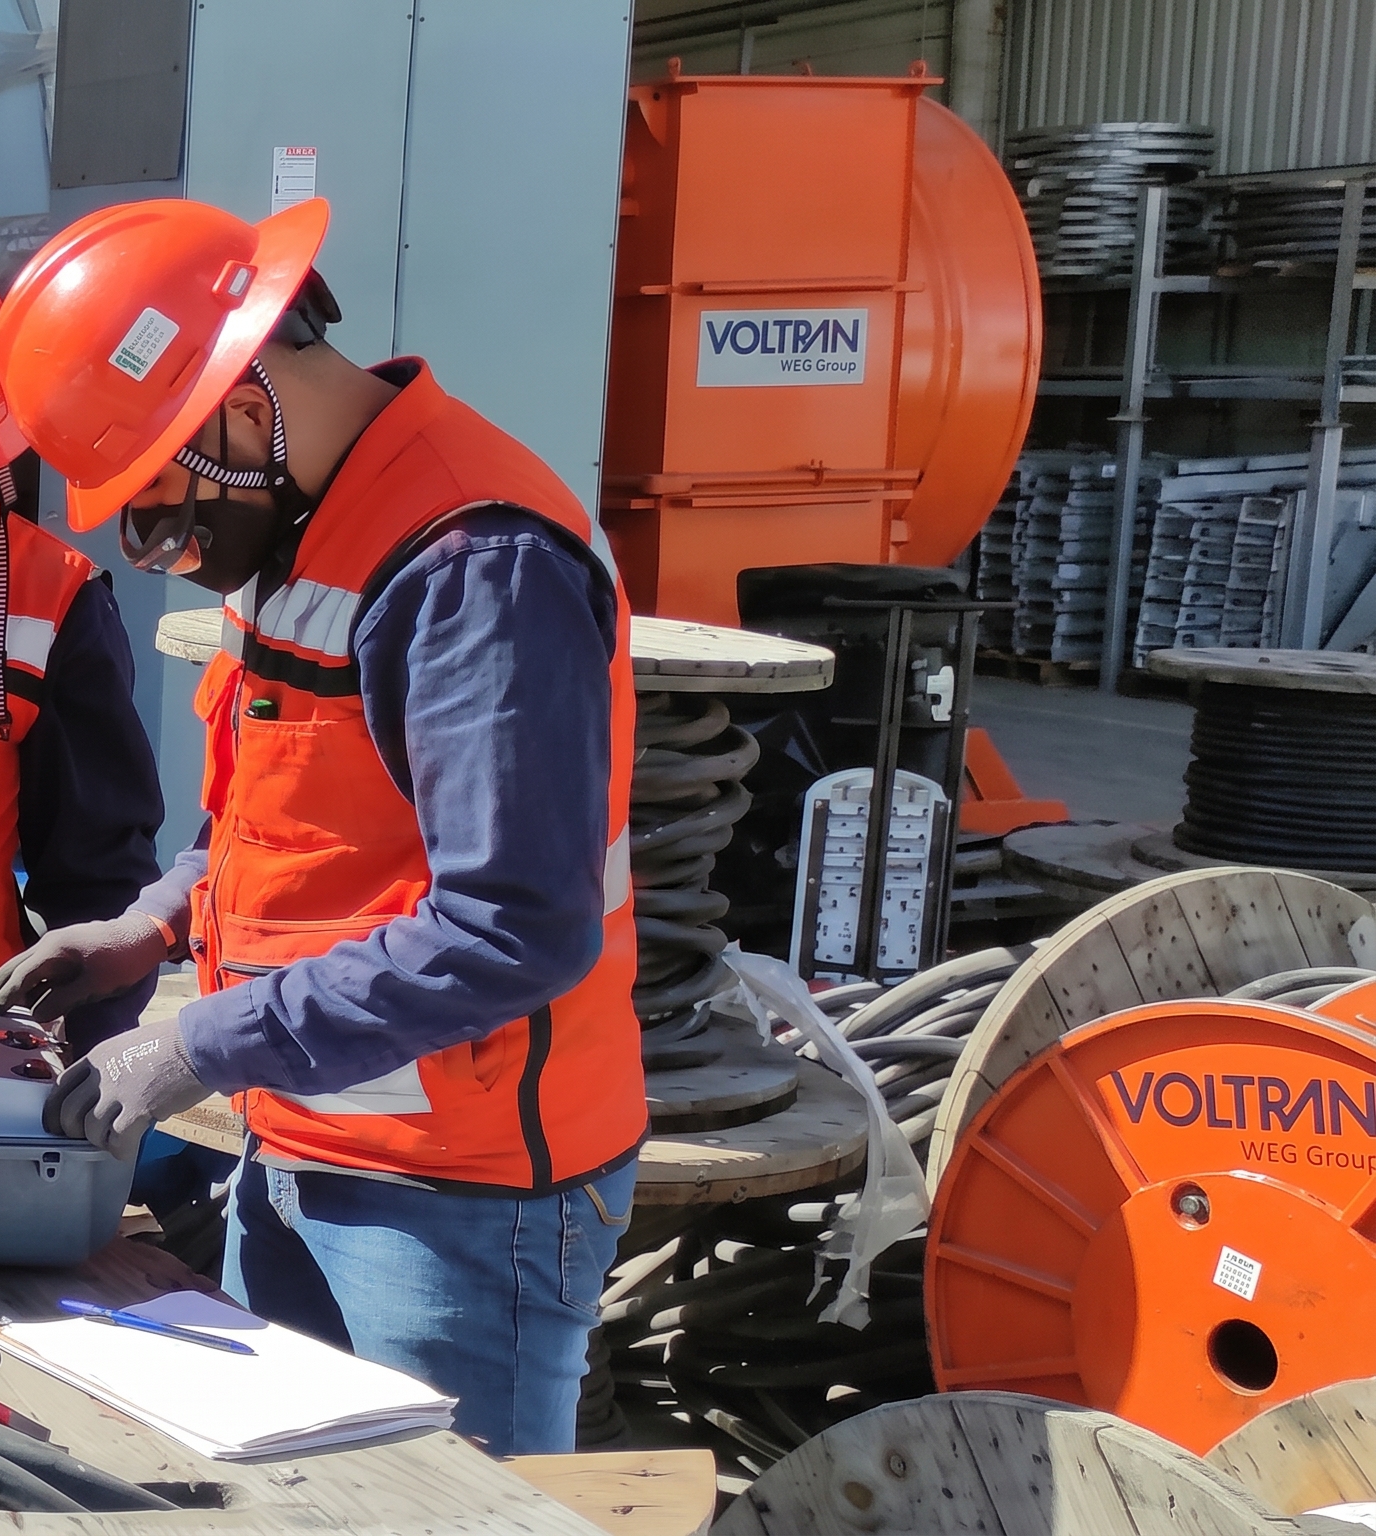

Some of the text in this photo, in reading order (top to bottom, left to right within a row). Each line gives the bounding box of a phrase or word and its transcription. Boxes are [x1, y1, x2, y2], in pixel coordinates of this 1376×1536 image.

[706, 319, 860, 355] VOLTRAN
[780, 359, 857, 374] WEG Group
[1110, 1071, 1376, 1138] VOLTRAN
[1240, 1140, 1298, 1164] WEG
